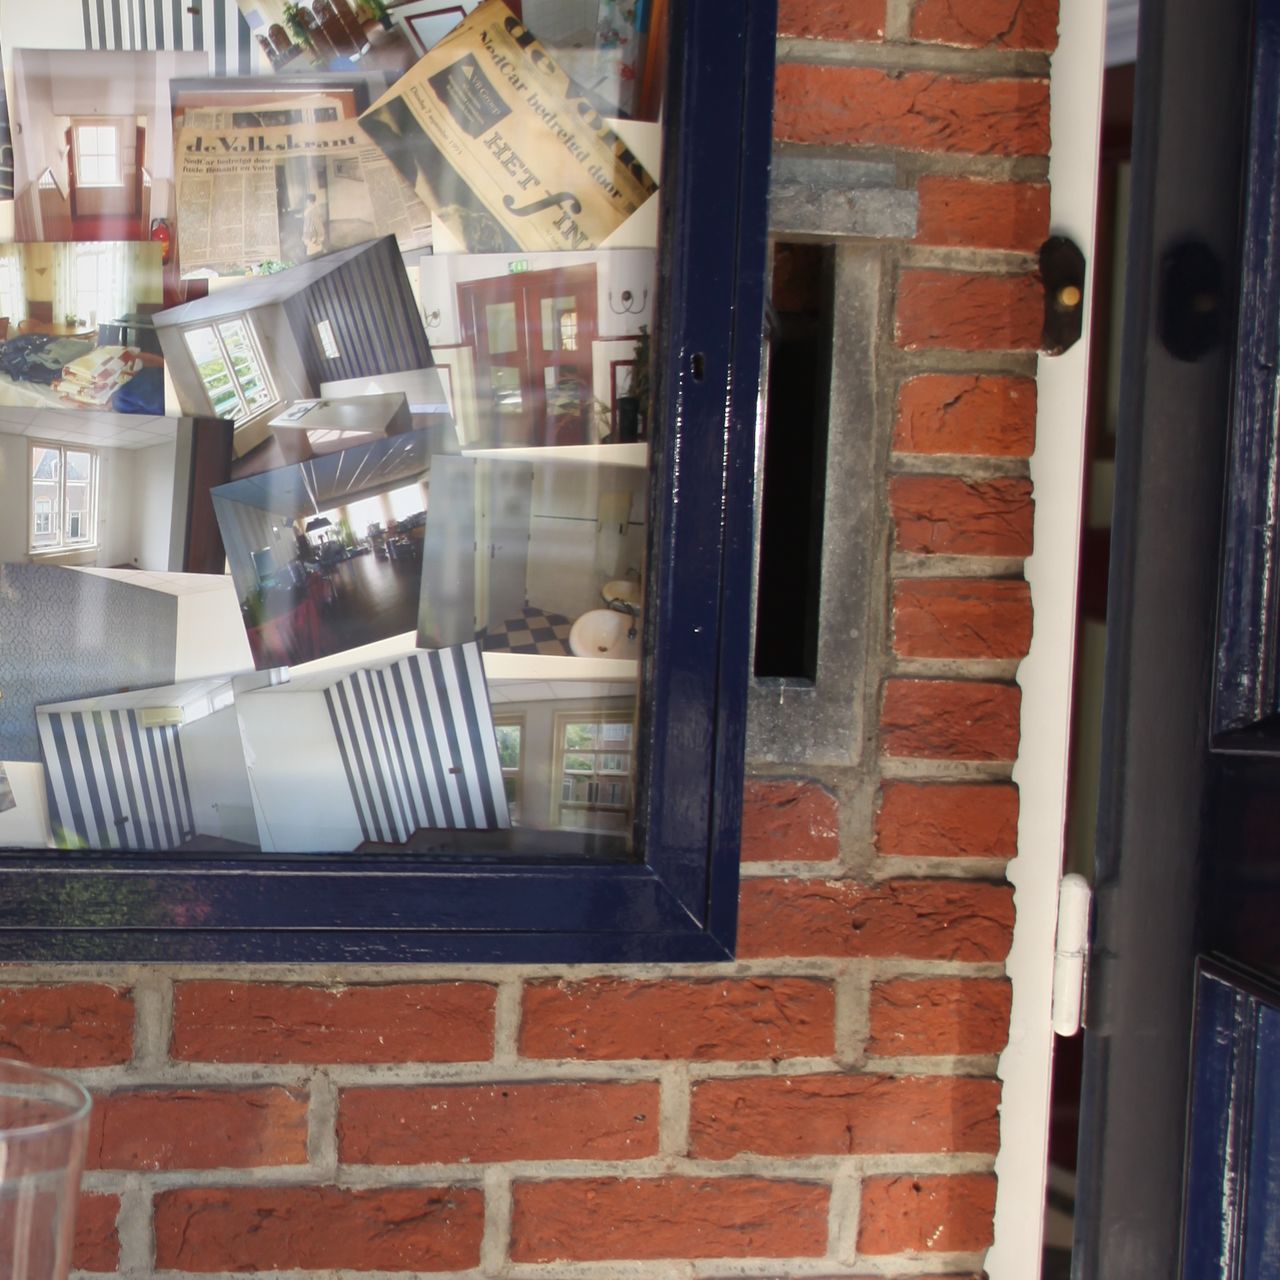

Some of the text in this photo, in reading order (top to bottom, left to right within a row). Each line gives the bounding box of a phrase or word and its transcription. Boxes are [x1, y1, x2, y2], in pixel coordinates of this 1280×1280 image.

[185, 136, 216, 153] de
[479, 30, 528, 93] NedCar
[525, 93, 591, 166] bedreigd
[587, 163, 623, 200] door
[483, 130, 541, 192] HET
